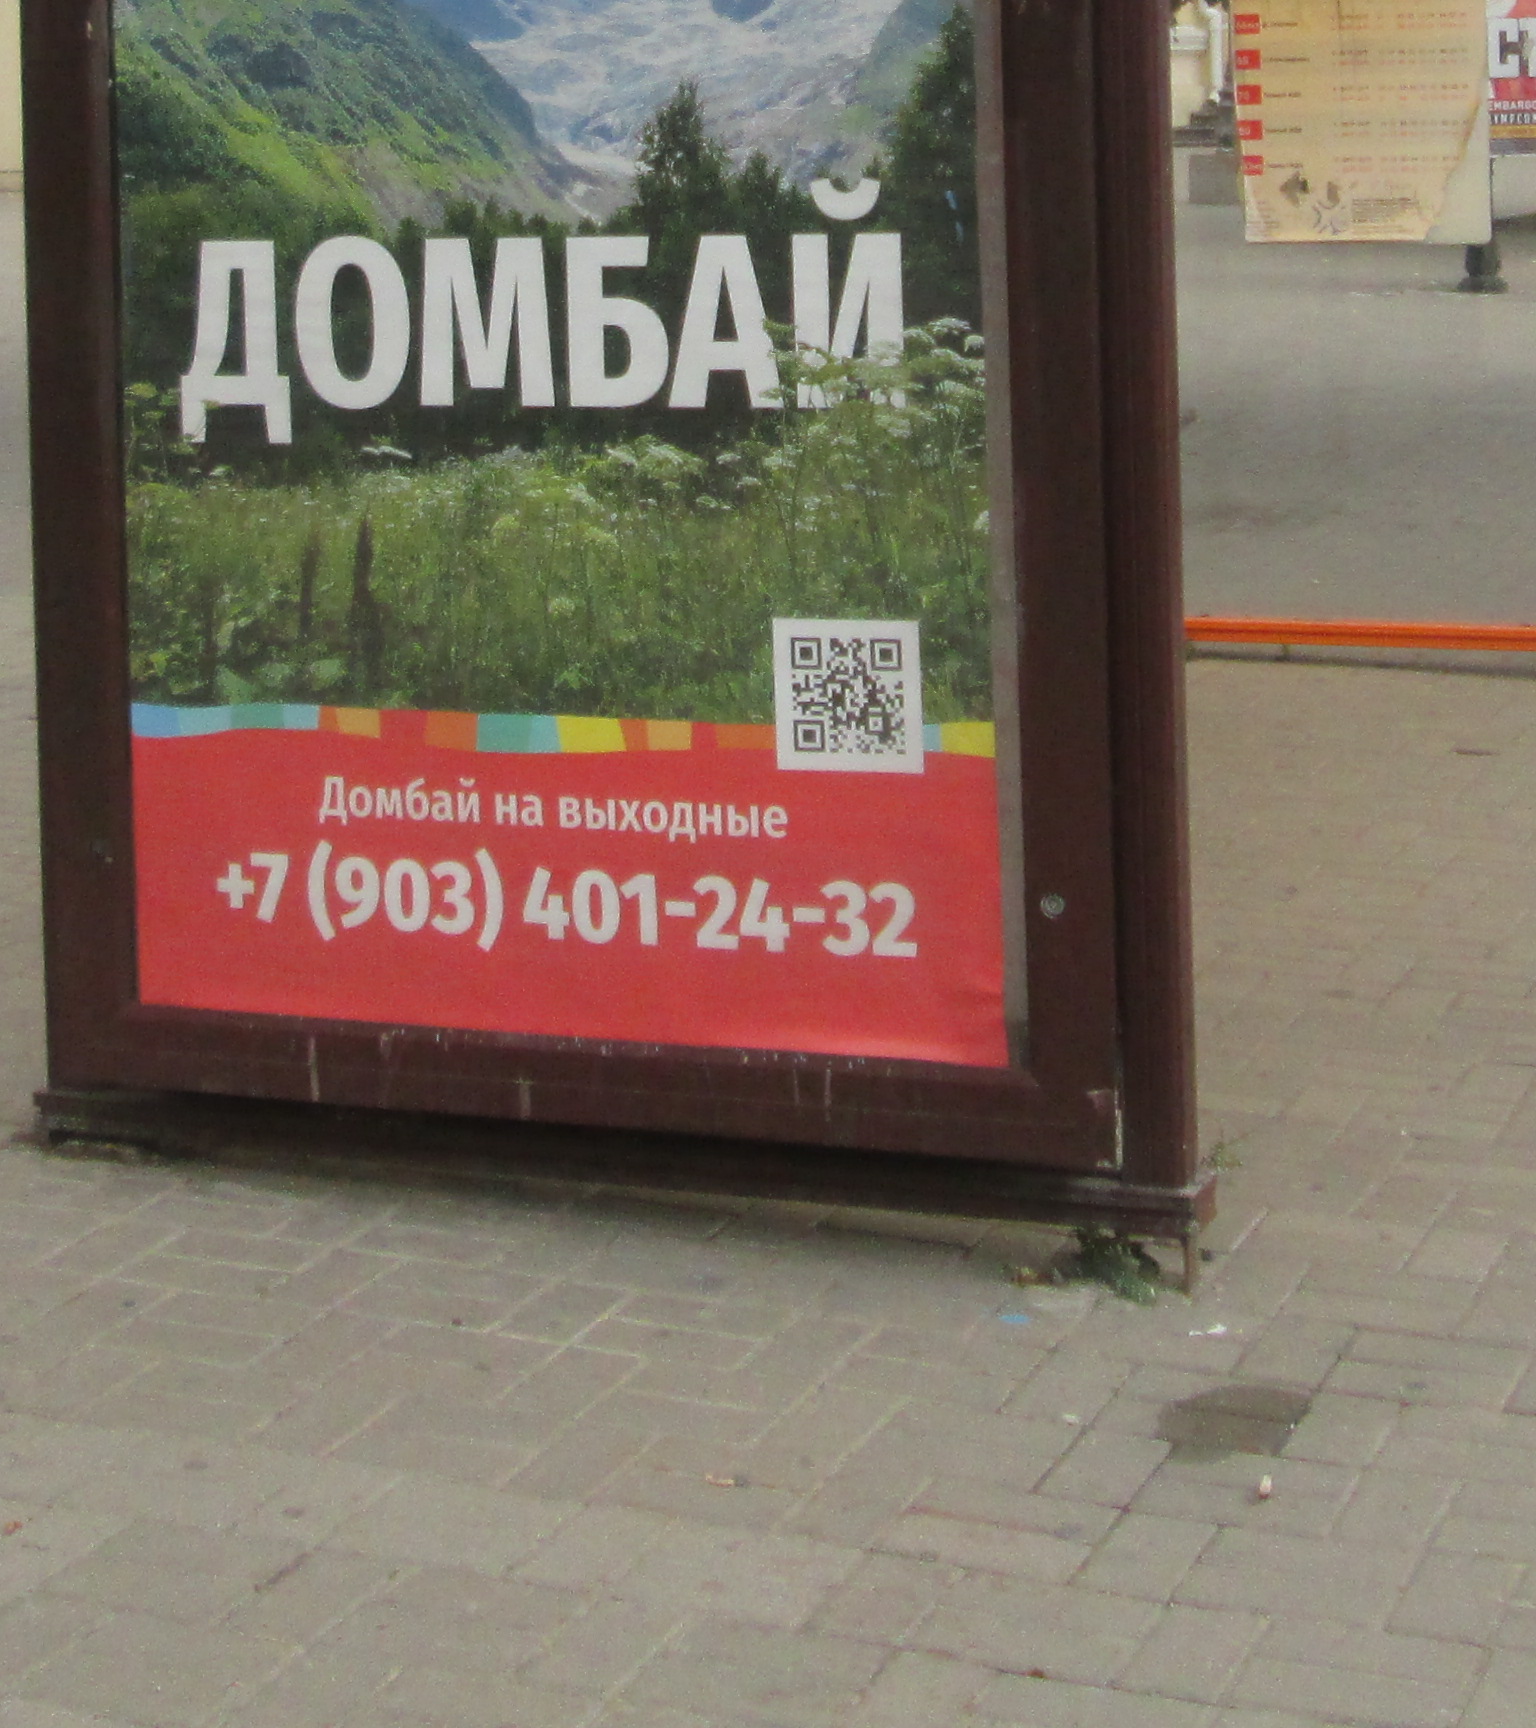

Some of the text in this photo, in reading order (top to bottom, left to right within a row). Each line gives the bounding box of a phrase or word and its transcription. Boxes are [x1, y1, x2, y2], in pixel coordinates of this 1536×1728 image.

[180, 177, 906, 445] ДОМБАЙ
[317, 775, 789, 840] Домбай на выходные
[216, 839, 919, 959] +7 (903) 401-24-32
